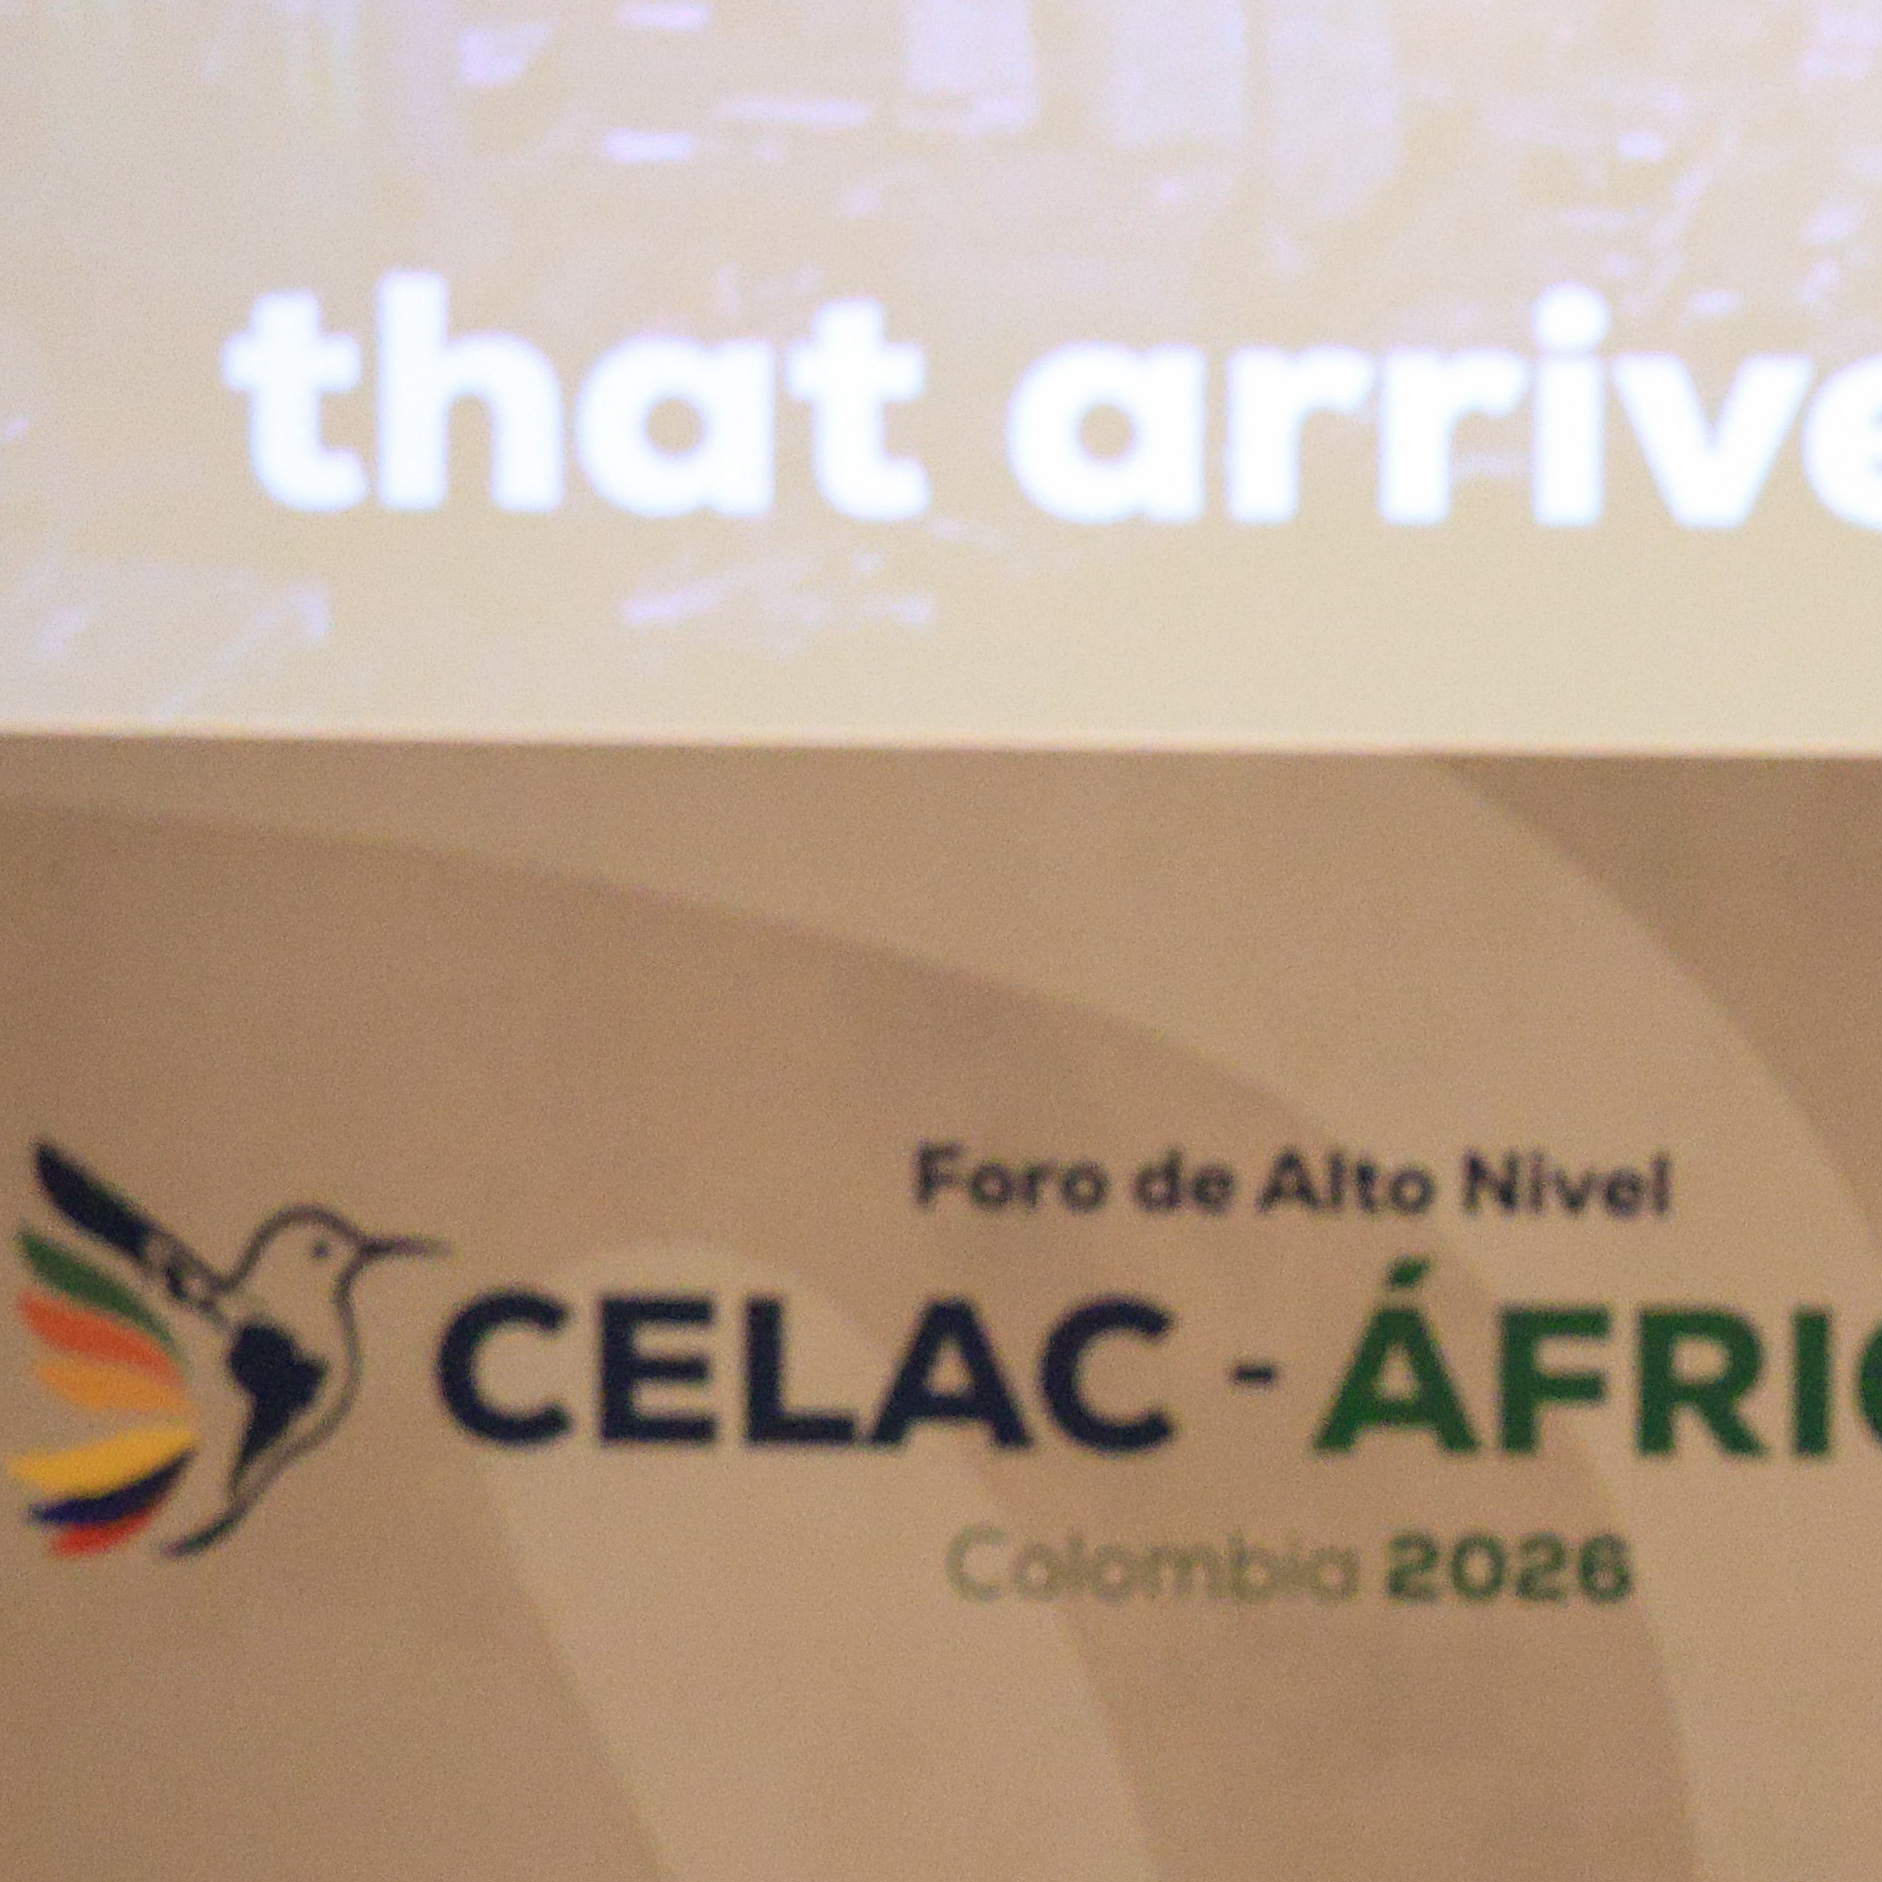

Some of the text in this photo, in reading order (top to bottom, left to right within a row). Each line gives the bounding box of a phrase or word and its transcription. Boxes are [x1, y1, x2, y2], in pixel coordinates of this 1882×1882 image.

[230, 272, 926, 514] that
[915, 1141, 1672, 1221] Foro de Alto Nivel
[436, 1287, 1180, 1457] CELAC
[1230, 1359, 1280, 1390] -
[945, 1524, 1636, 1608] Colombia 2026
